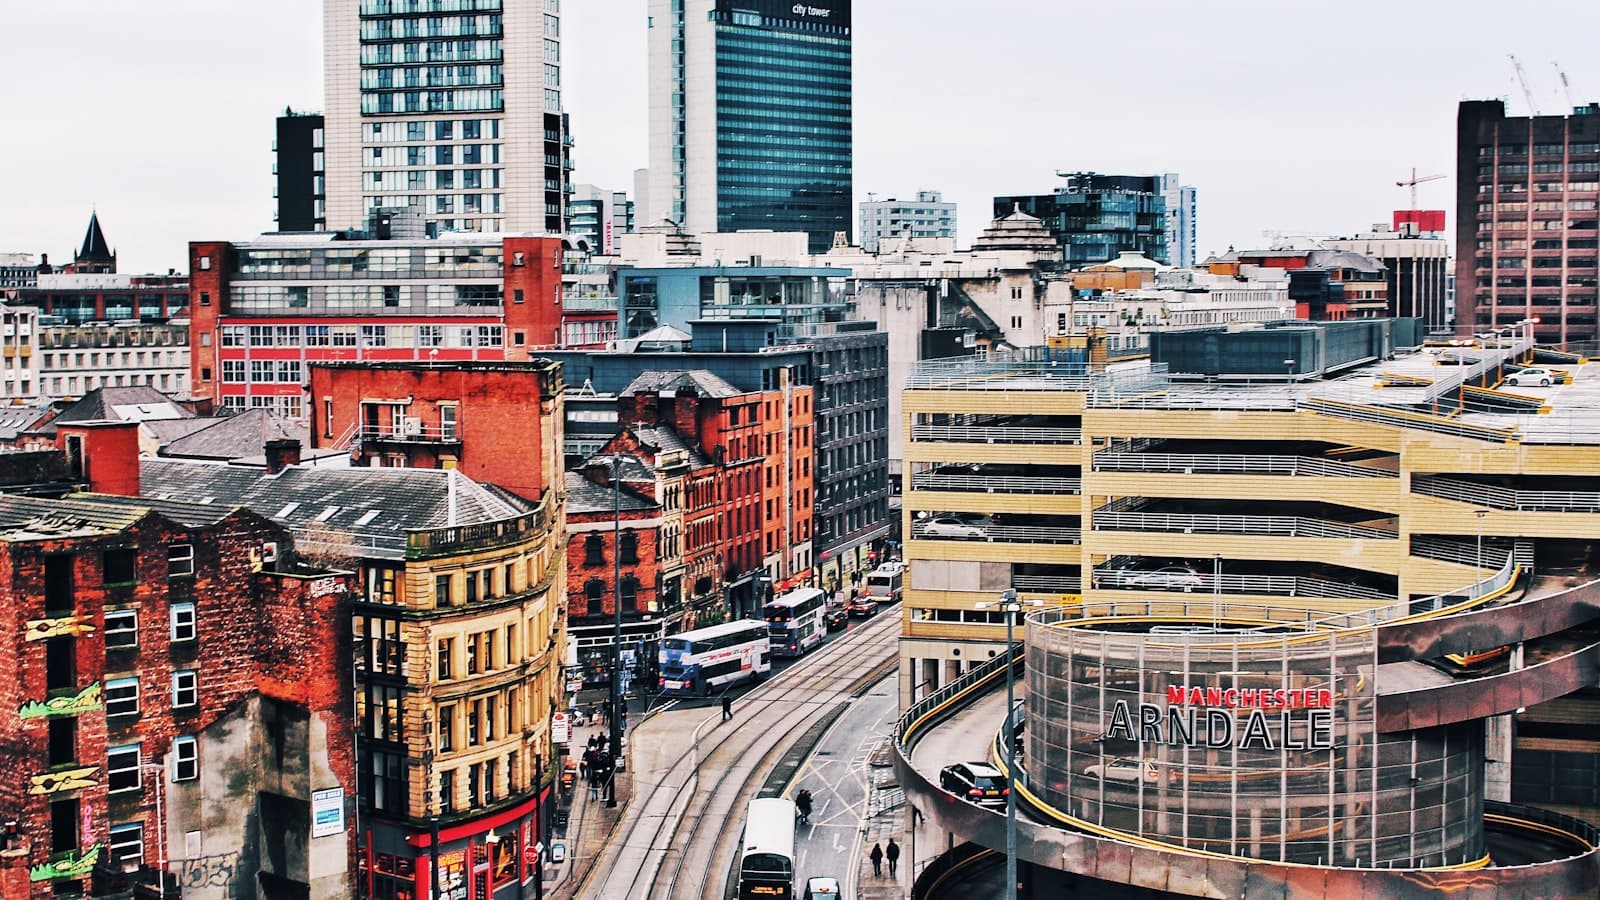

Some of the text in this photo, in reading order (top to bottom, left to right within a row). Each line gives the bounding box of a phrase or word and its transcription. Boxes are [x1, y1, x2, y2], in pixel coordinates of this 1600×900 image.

[792, 3, 831, 17] city tower
[1168, 686, 1332, 708] MANCHESTER
[1107, 700, 1332, 750] ARNDALE
[423, 708, 433, 816] CHAMBERS
